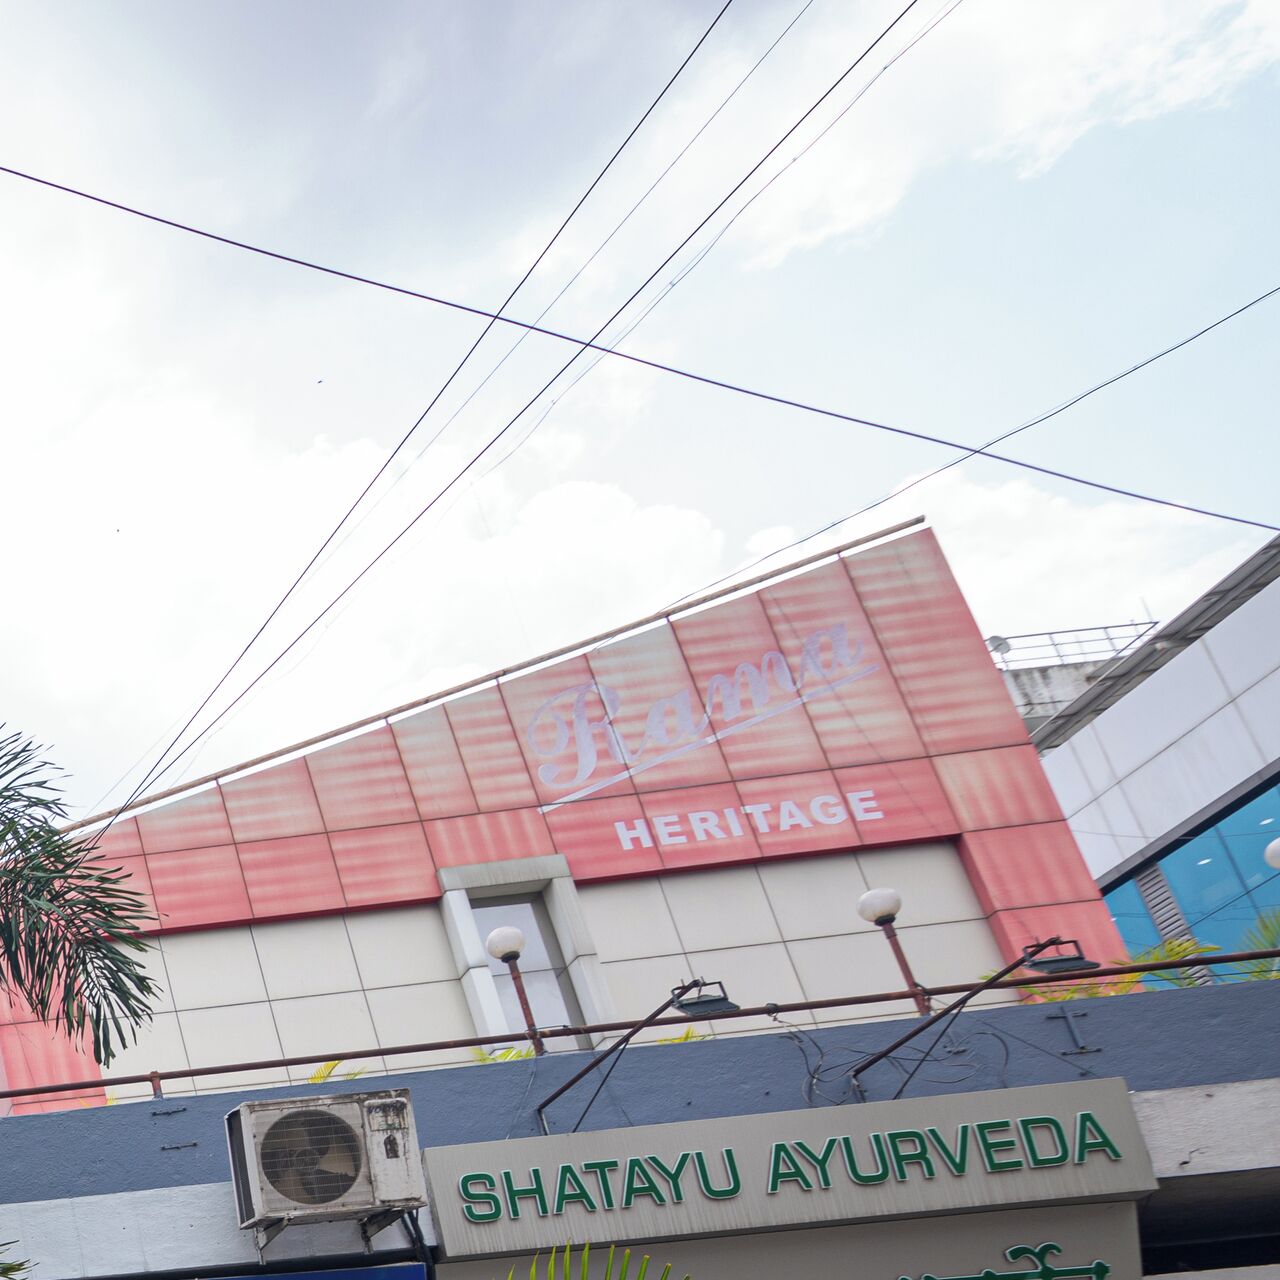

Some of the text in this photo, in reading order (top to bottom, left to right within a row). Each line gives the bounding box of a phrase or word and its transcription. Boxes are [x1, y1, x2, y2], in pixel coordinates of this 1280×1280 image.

[527, 622, 865, 790] Rama
[614, 790, 884, 851] HERITAGE
[459, 1111, 1123, 1224] SHATAYU AYURVEDA
